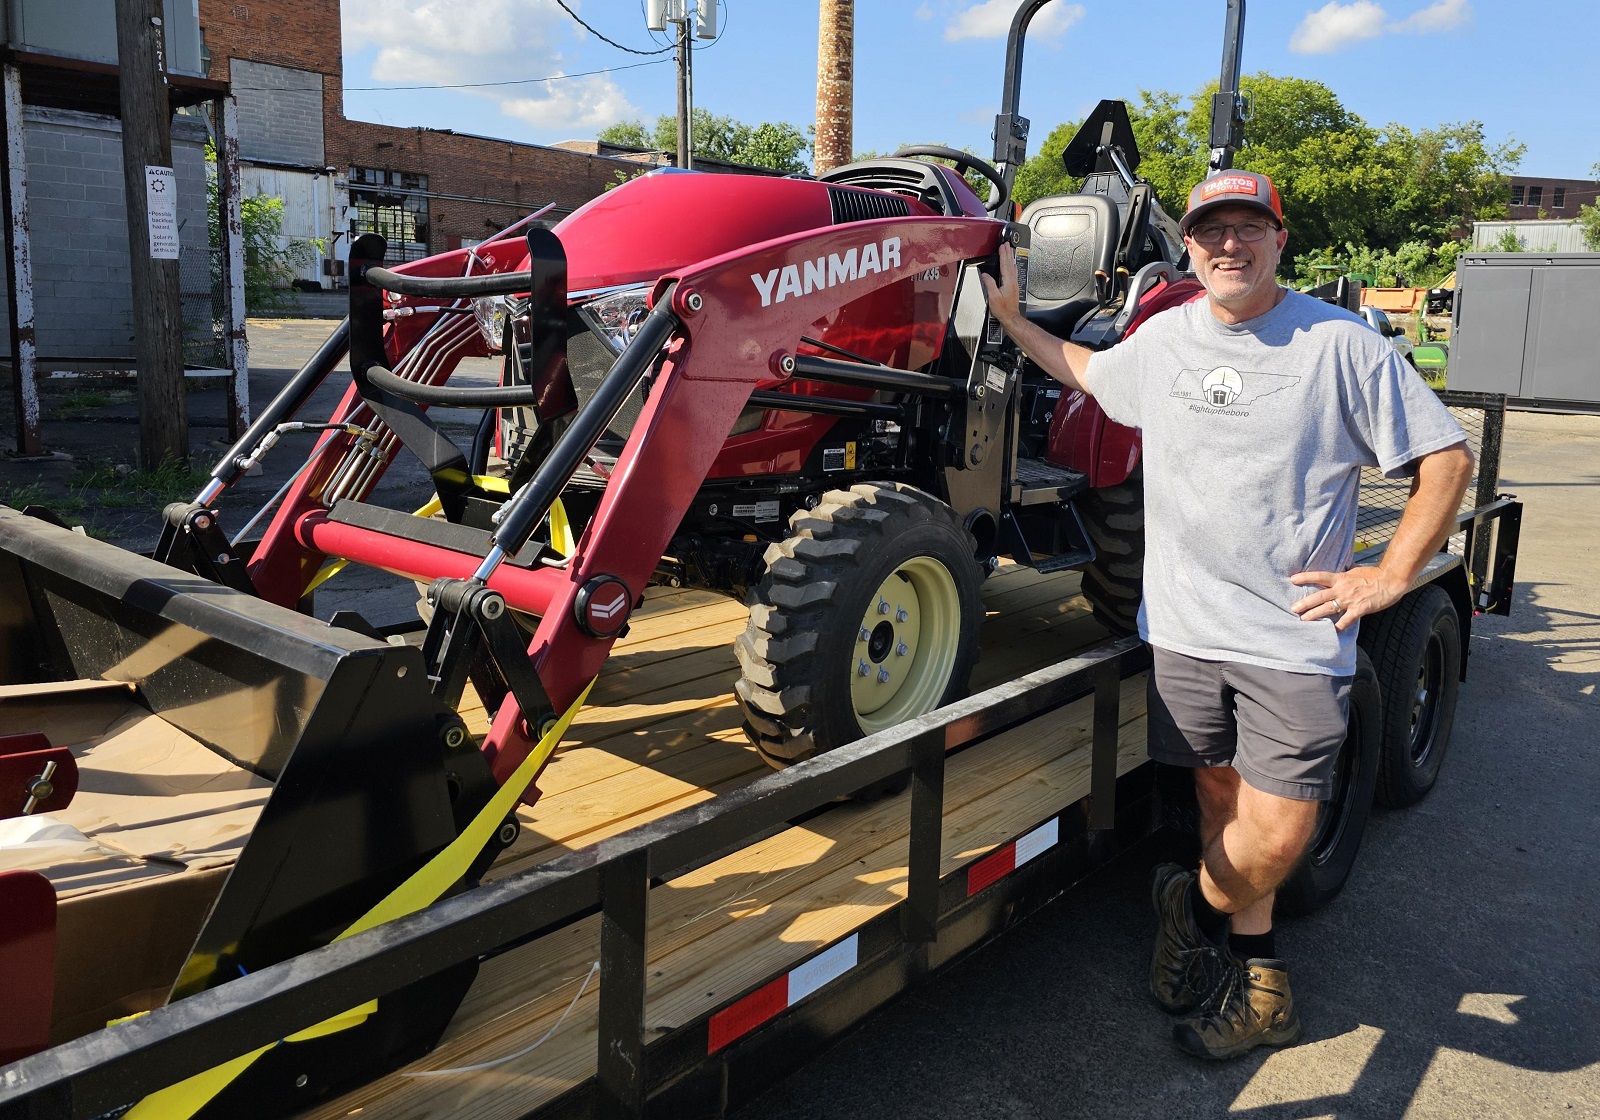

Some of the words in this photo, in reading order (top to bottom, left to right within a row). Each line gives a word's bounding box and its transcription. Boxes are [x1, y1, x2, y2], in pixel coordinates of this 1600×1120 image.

[155, 28, 163, 71] 3371
[1204, 178, 1255, 193] TRACTOR
[750, 236, 901, 308] YANMAR
[1188, 404, 1250, 418] #lightuptheboro
